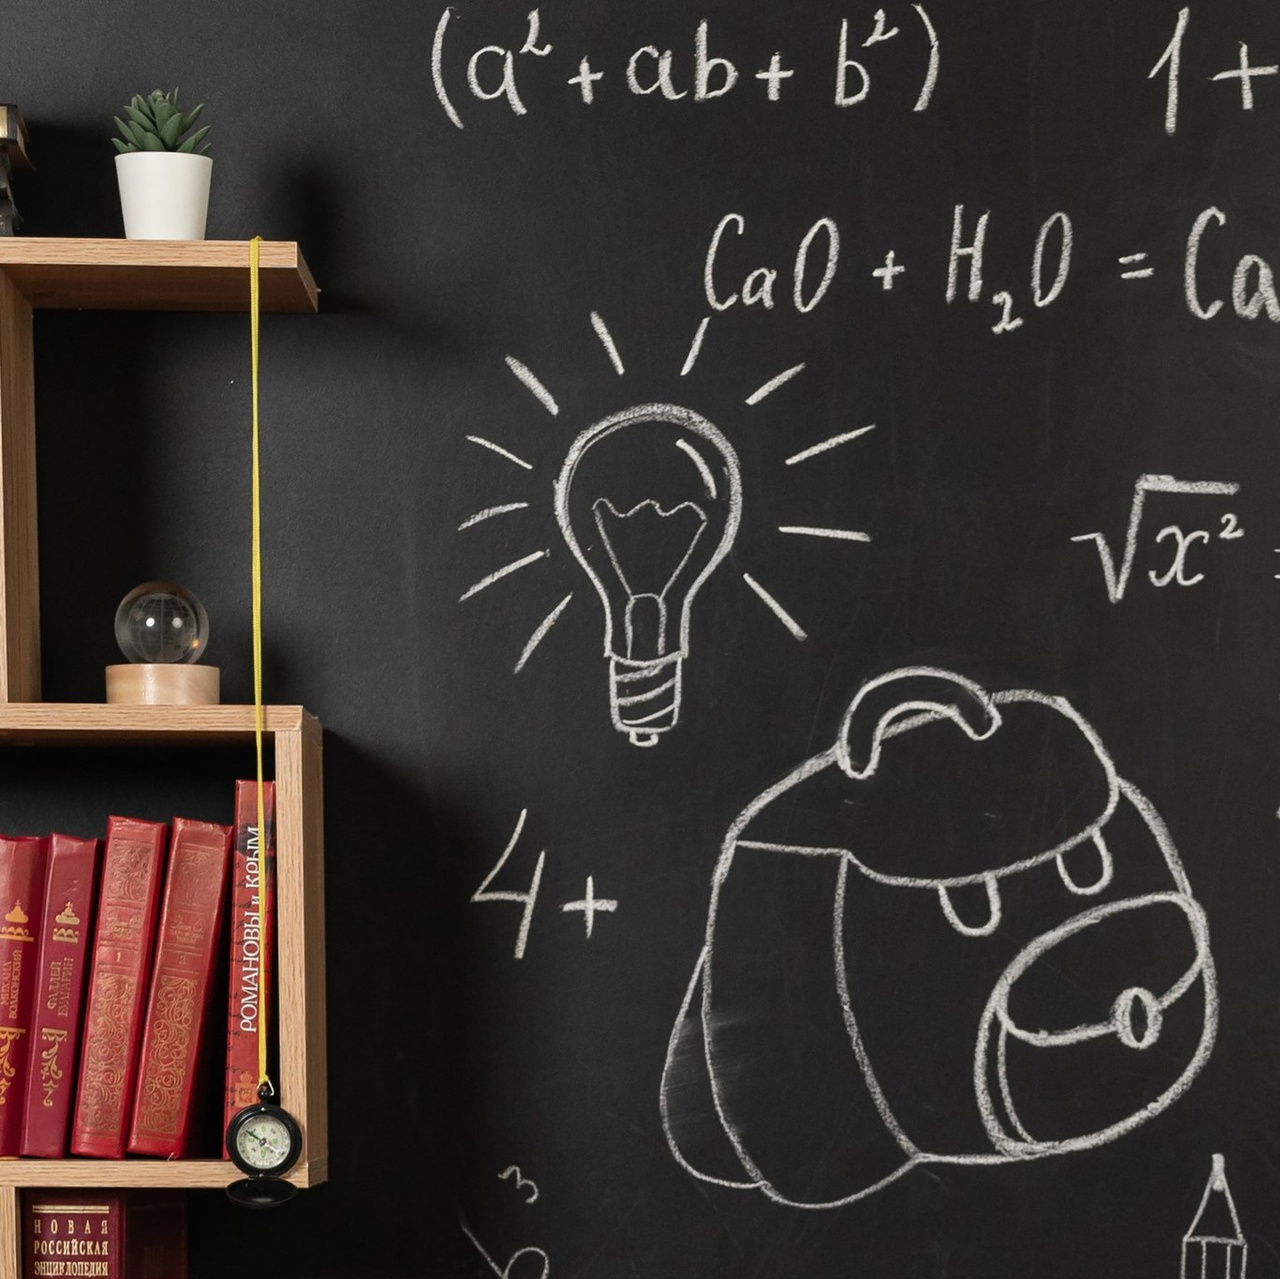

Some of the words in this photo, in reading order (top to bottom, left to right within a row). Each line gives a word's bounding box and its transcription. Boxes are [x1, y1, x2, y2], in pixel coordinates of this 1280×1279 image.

[245, 826, 262, 889] КРЫМ
[473, 809, 617, 958] 4+
[8, 949, 23, 1020] ВОЛКОНСКИЙ
[57, 957, 75, 1017] БУЛГАРИН
[240, 910, 263, 1033] РОМАНОВЫ
[33, 1239, 109, 1256] РОССИЙСКАЯ
[34, 1219, 108, 1235] НОВАЯ
[34, 1260, 109, 1277] ЭНЦИКЛОПЕДИЯ
